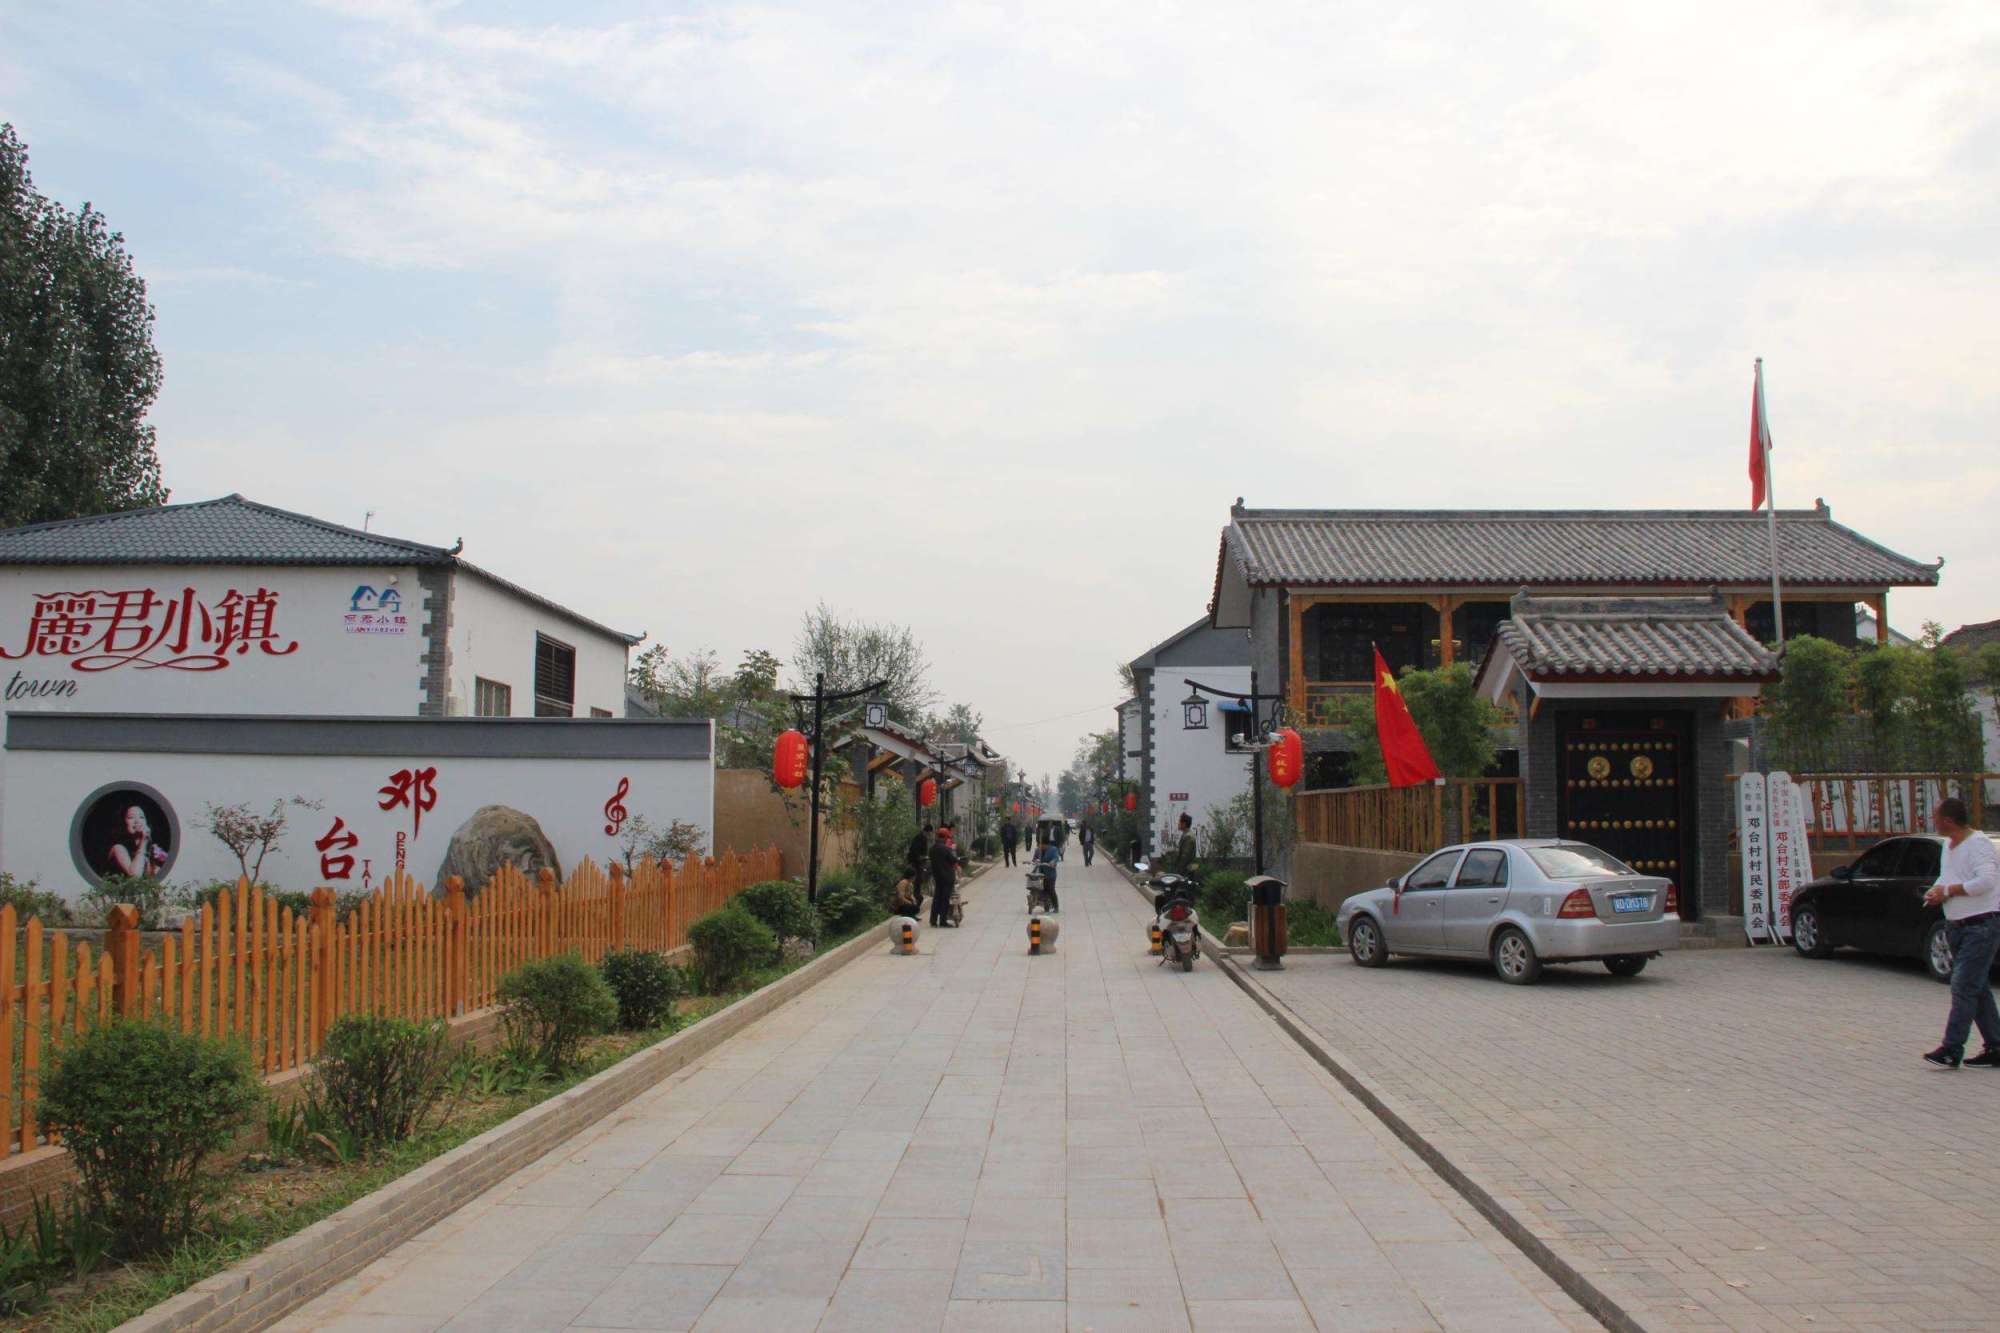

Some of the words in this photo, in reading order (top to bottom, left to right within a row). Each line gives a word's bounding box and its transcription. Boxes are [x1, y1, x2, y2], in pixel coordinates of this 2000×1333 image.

[5, 670, 79, 701] town
[395, 831, 406, 869] DENG
[362, 859, 373, 888] TAI
[1747, 817, 1764, 928] 邓台村村民委员会
[1775, 831, 1792, 926] 邓台村支部委员会
